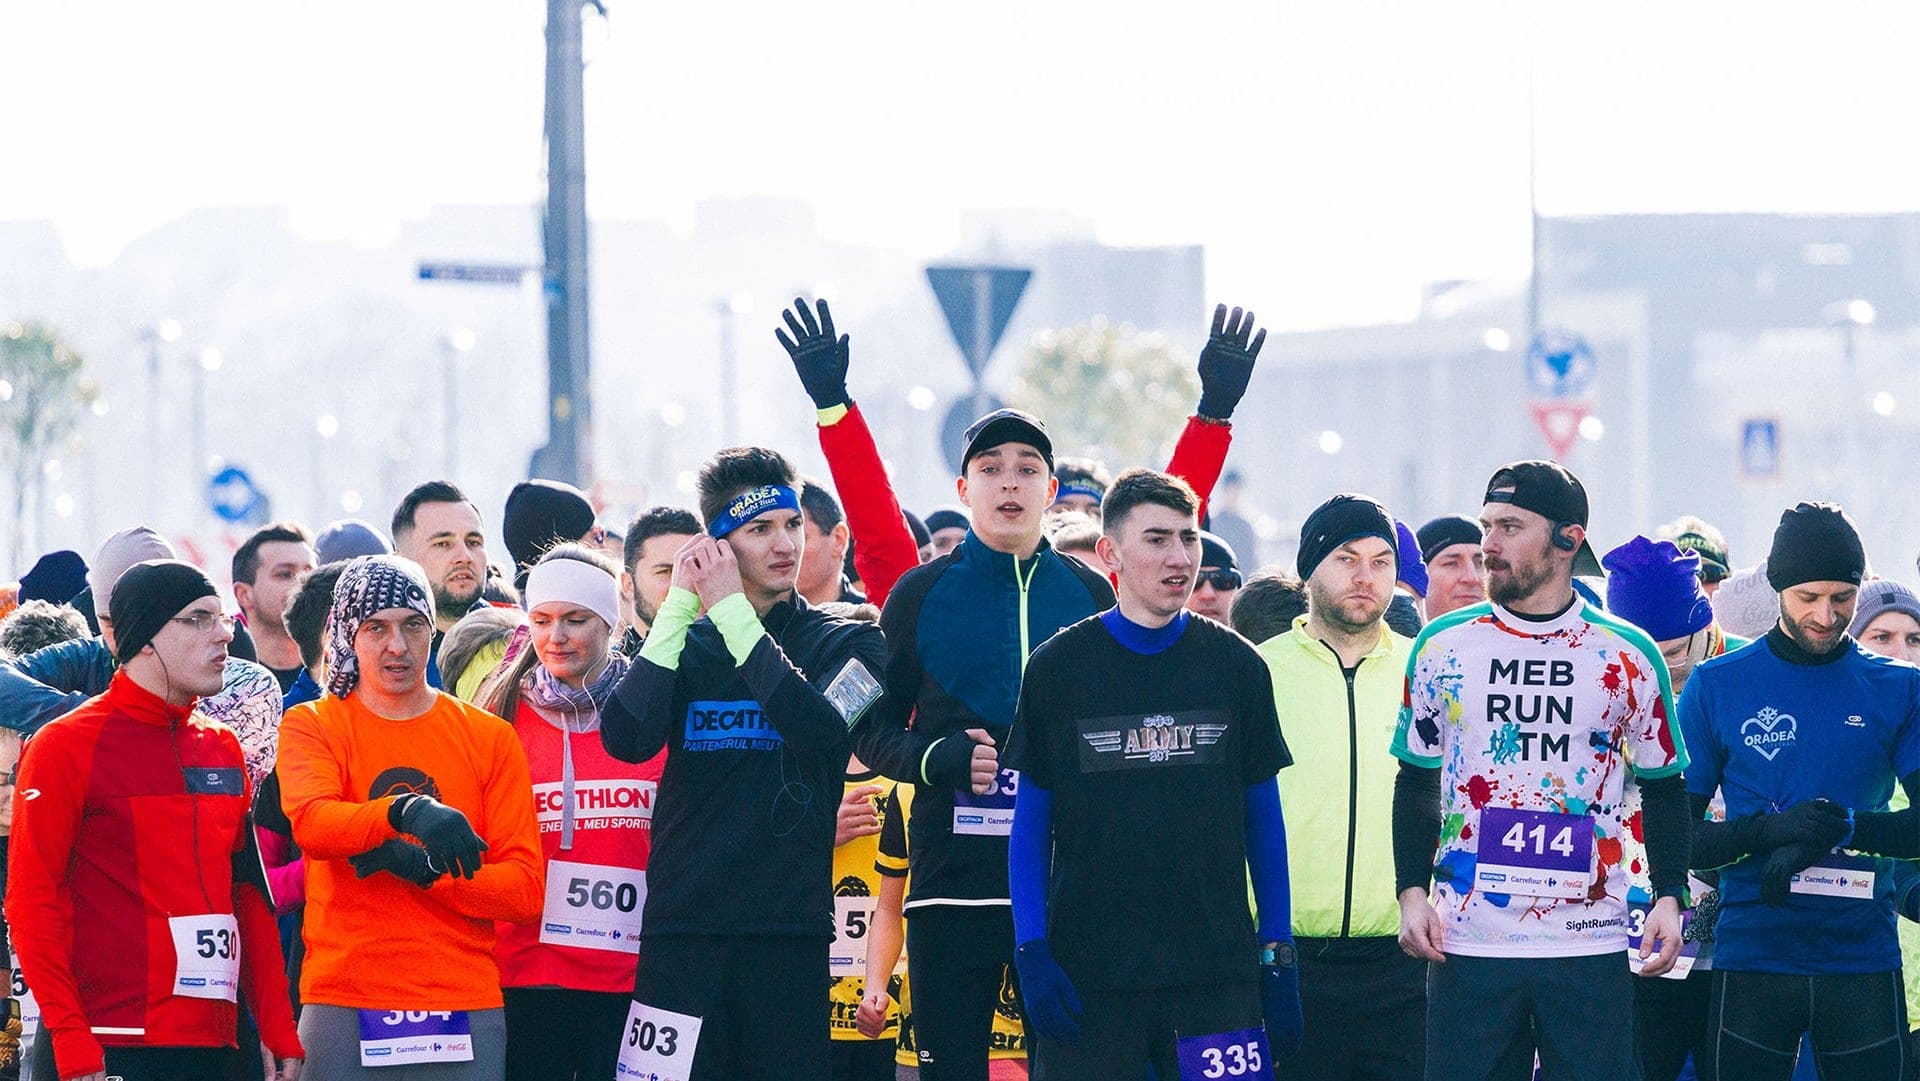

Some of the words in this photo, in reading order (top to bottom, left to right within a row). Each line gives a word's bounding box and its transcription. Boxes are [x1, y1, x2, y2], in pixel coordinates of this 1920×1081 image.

[730, 487, 781, 517] ORADEA
[1489, 658, 1574, 686] MEB
[1487, 694, 1573, 724] RUN
[683, 739, 748, 752] PARTENERUL
[751, 740, 775, 751] MEU
[1124, 724, 1195, 753] ARMY
[1517, 732, 1570, 762] TM
[1744, 730, 1796, 746] ORADEA
[583, 819, 609, 830] MEU
[1502, 822, 1574, 857] 414
[566, 877, 638, 912] 560
[1511, 876, 1542, 885] Carrefour
[1804, 876, 1834, 885] Carrefour
[197, 928, 237, 960] 530
[576, 927, 607, 937] Carrefour
[396, 1045, 427, 1054] Carrefour
[629, 1017, 679, 1056] 503
[1202, 1041, 1261, 1078] 335
